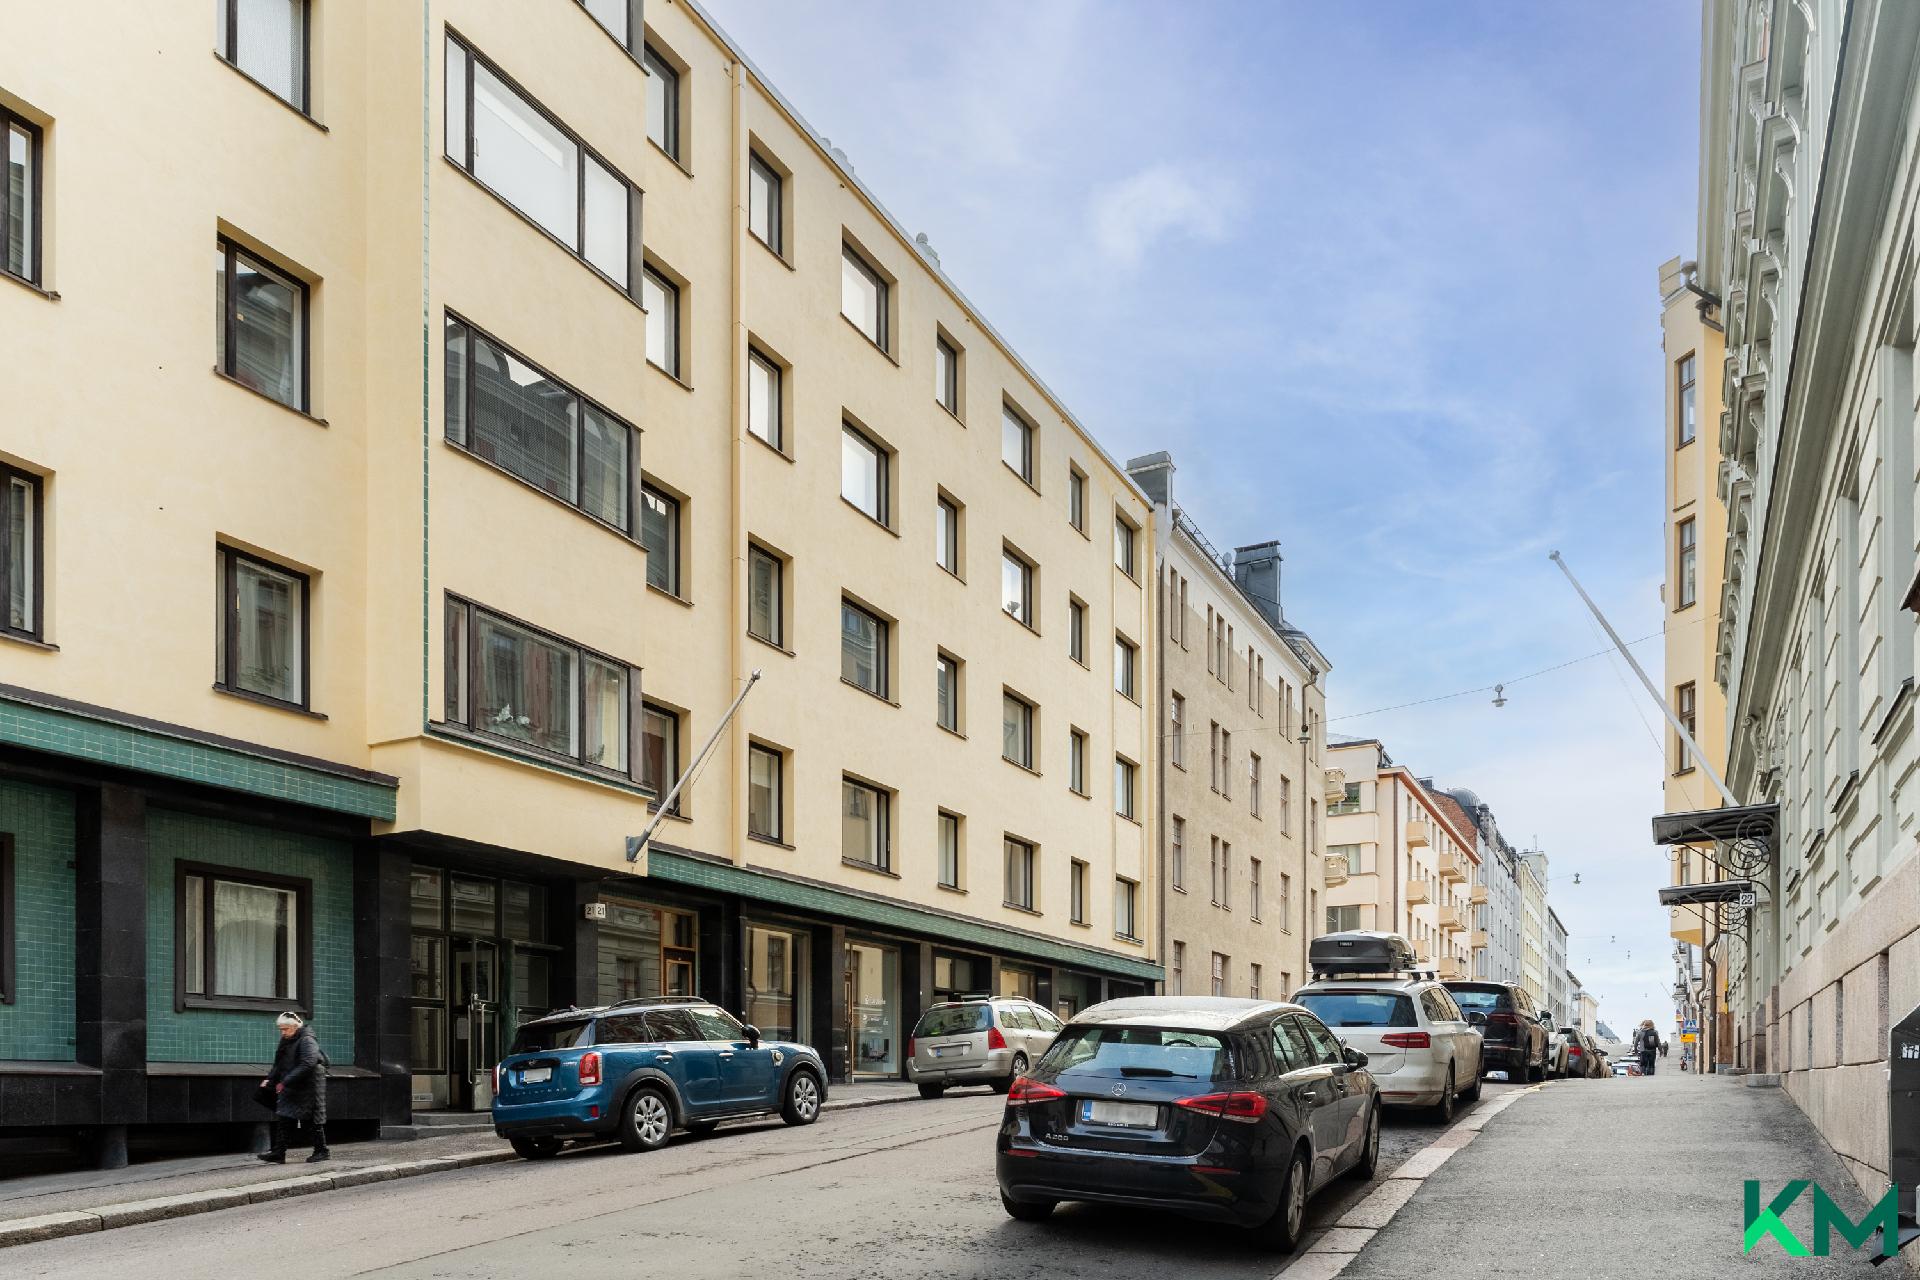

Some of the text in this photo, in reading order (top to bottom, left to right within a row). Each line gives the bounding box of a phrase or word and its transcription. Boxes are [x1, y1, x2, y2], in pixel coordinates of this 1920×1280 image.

[1741, 894, 1752, 905] 22
[586, 906, 595, 915] 21
[597, 906, 605, 916] 21
